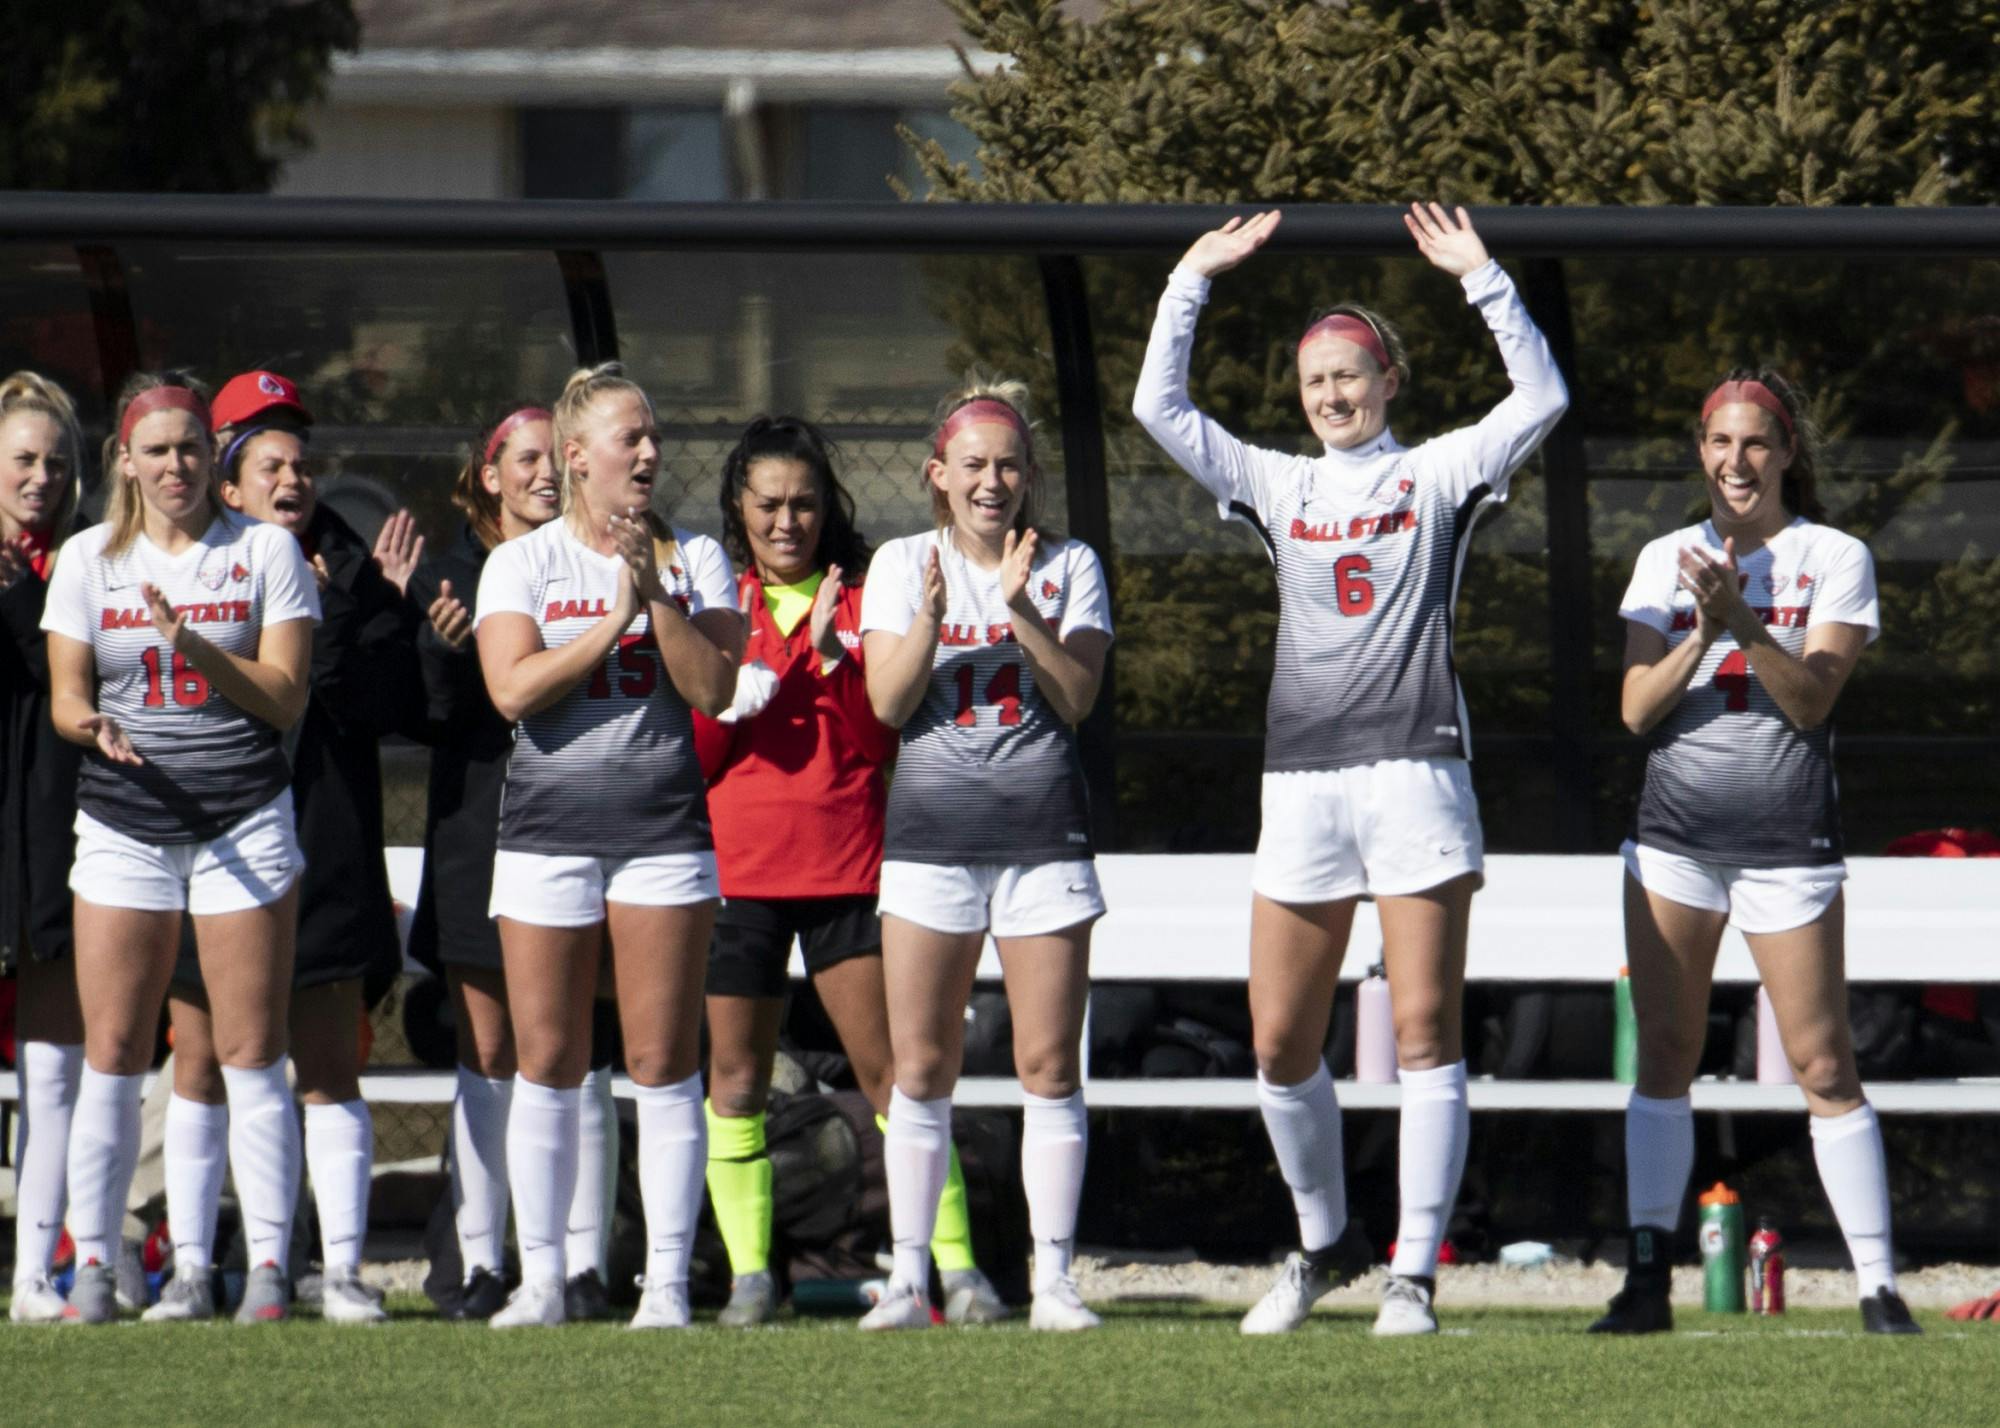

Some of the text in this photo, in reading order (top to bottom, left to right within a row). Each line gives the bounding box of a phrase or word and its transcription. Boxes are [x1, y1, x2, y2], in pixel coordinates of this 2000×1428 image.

[1289, 518, 1342, 541] BALL
[1333, 554, 1375, 617] 6
[101, 607, 153, 631] BAL
[545, 598, 609, 623] BALL
[938, 623, 981, 645] ALL
[141, 646, 209, 708] 16
[953, 664, 1022, 727] 14
[1713, 650, 1750, 711] 4
